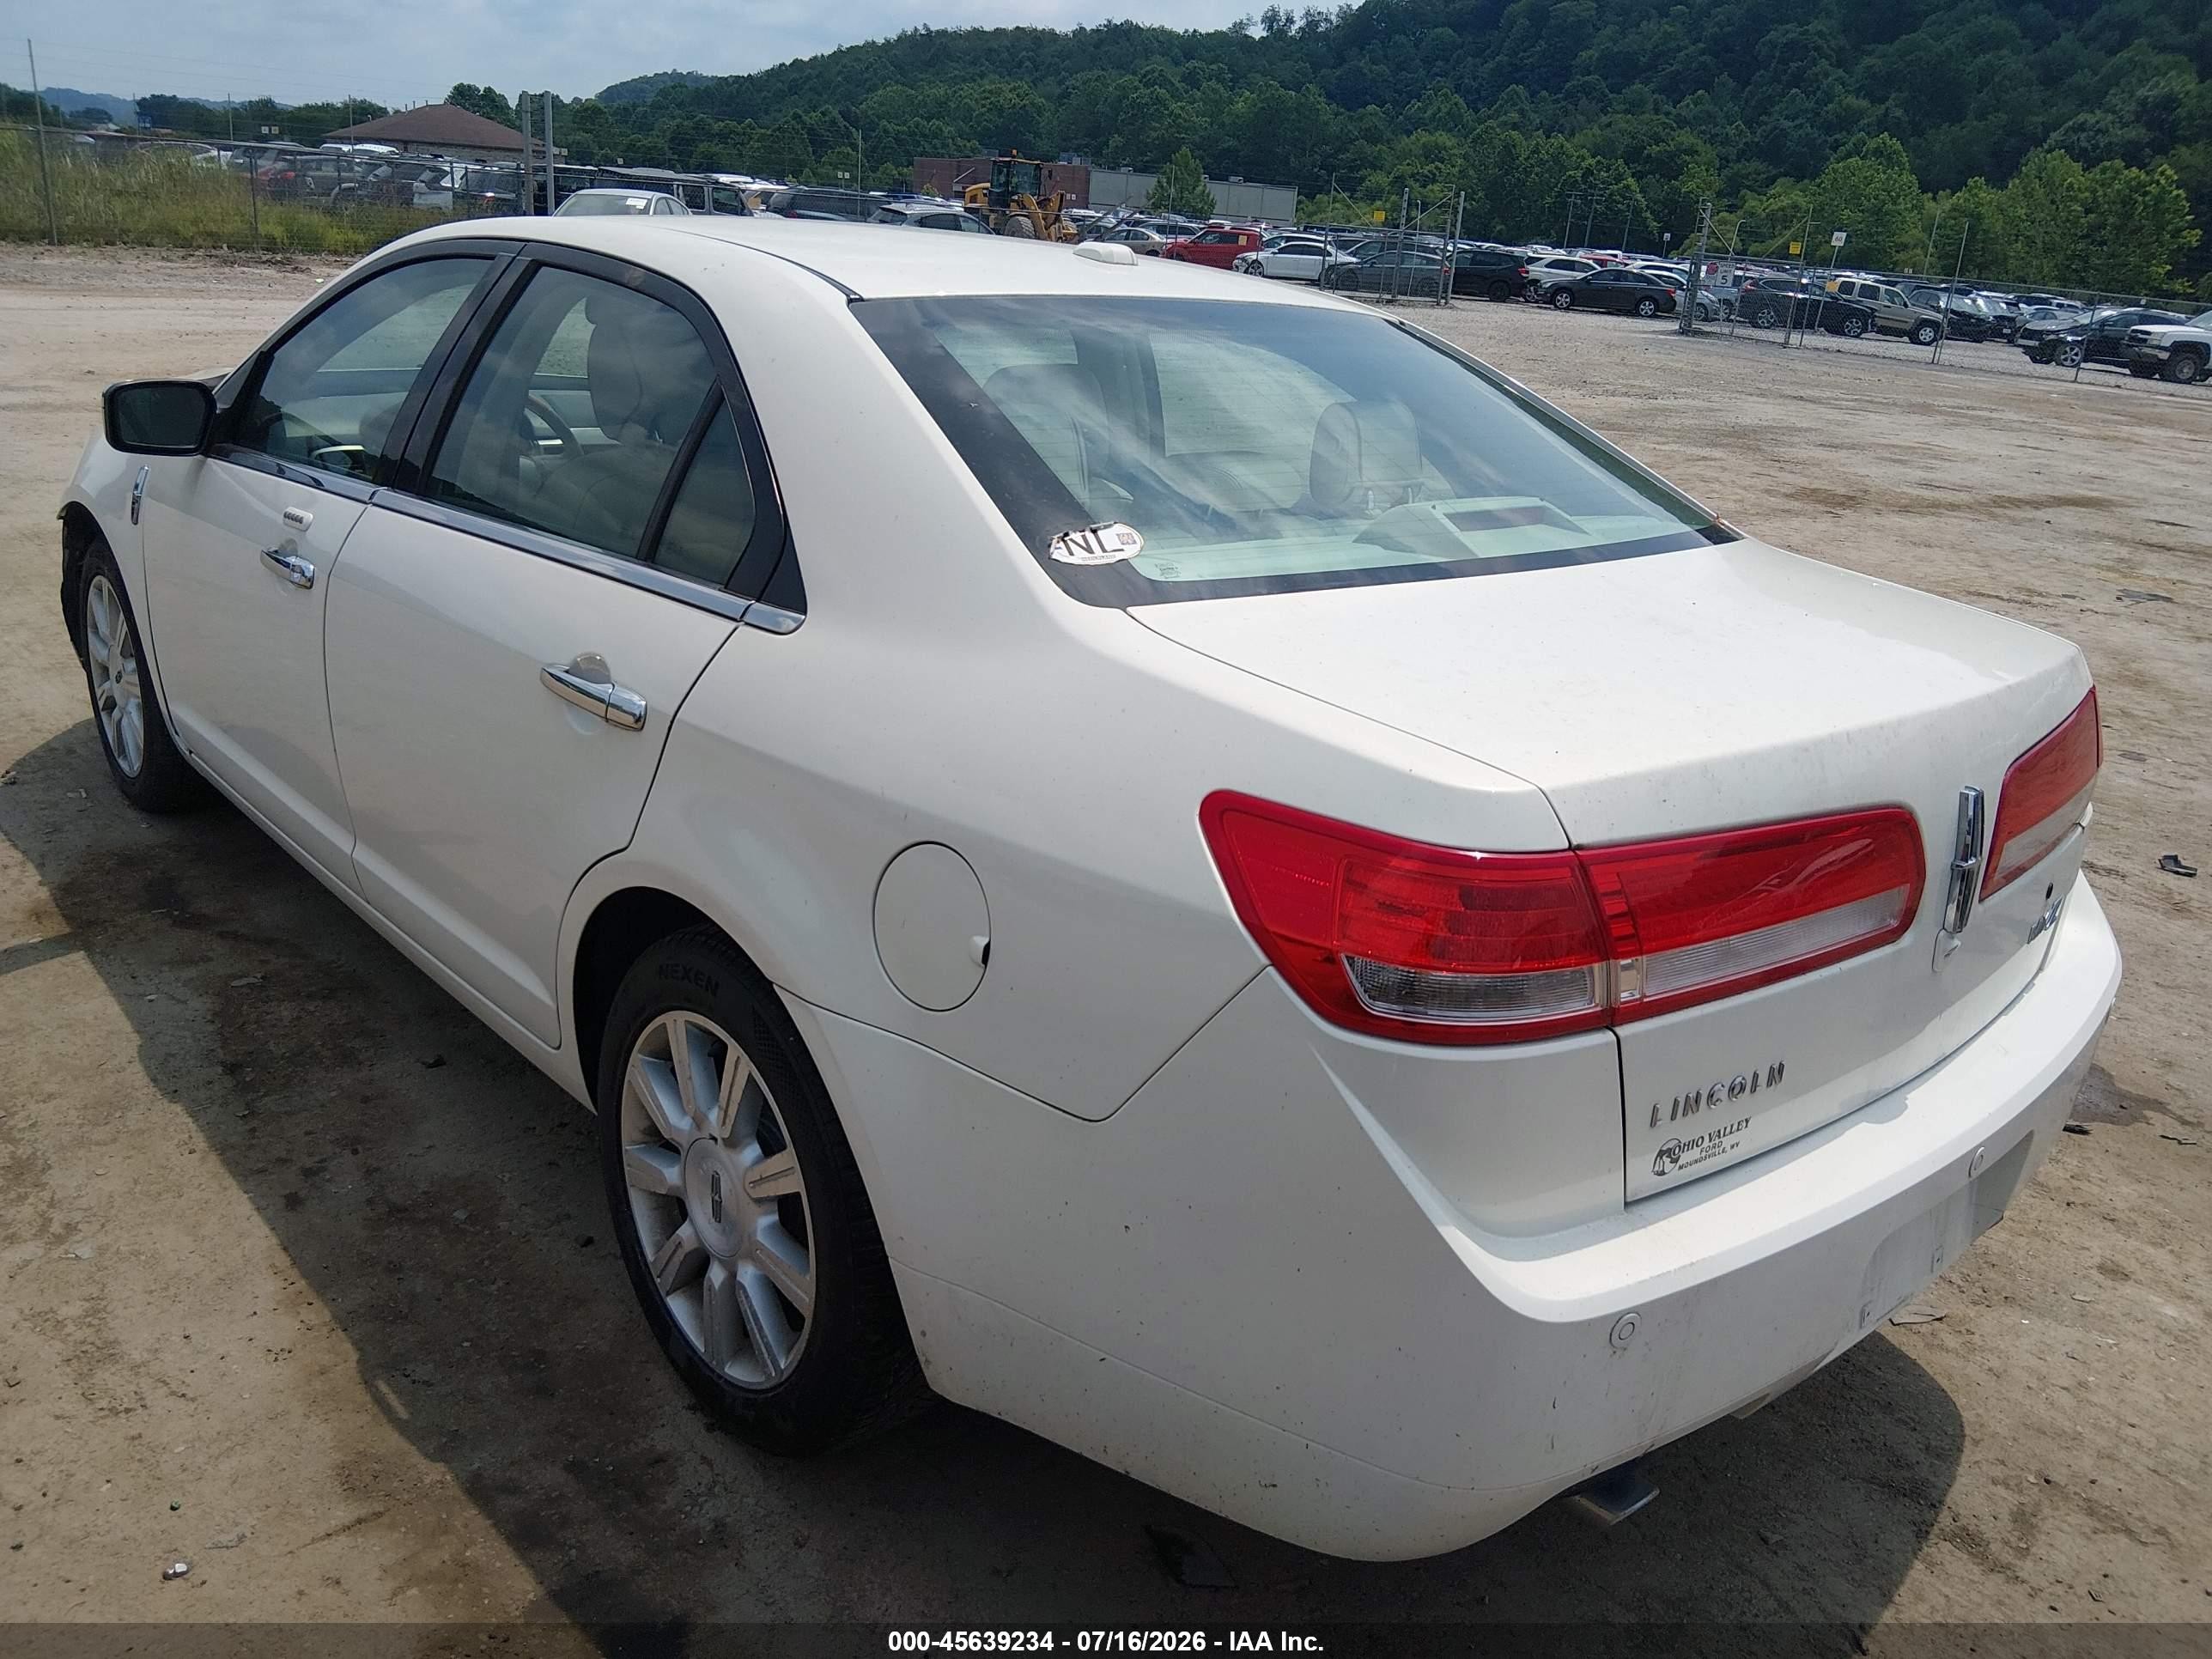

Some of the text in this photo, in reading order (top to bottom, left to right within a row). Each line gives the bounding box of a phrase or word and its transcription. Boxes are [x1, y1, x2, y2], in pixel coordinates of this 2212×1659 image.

[1720, 275, 1728, 285] 5
[659, 962, 720, 996] NEXEN
[1650, 1060, 1785, 1128] LINCOLN
[1672, 1116, 1752, 1157] OHIO VALLEY
[1699, 1140, 1723, 1155] FORD
[1729, 1140, 1741, 1151] WV
